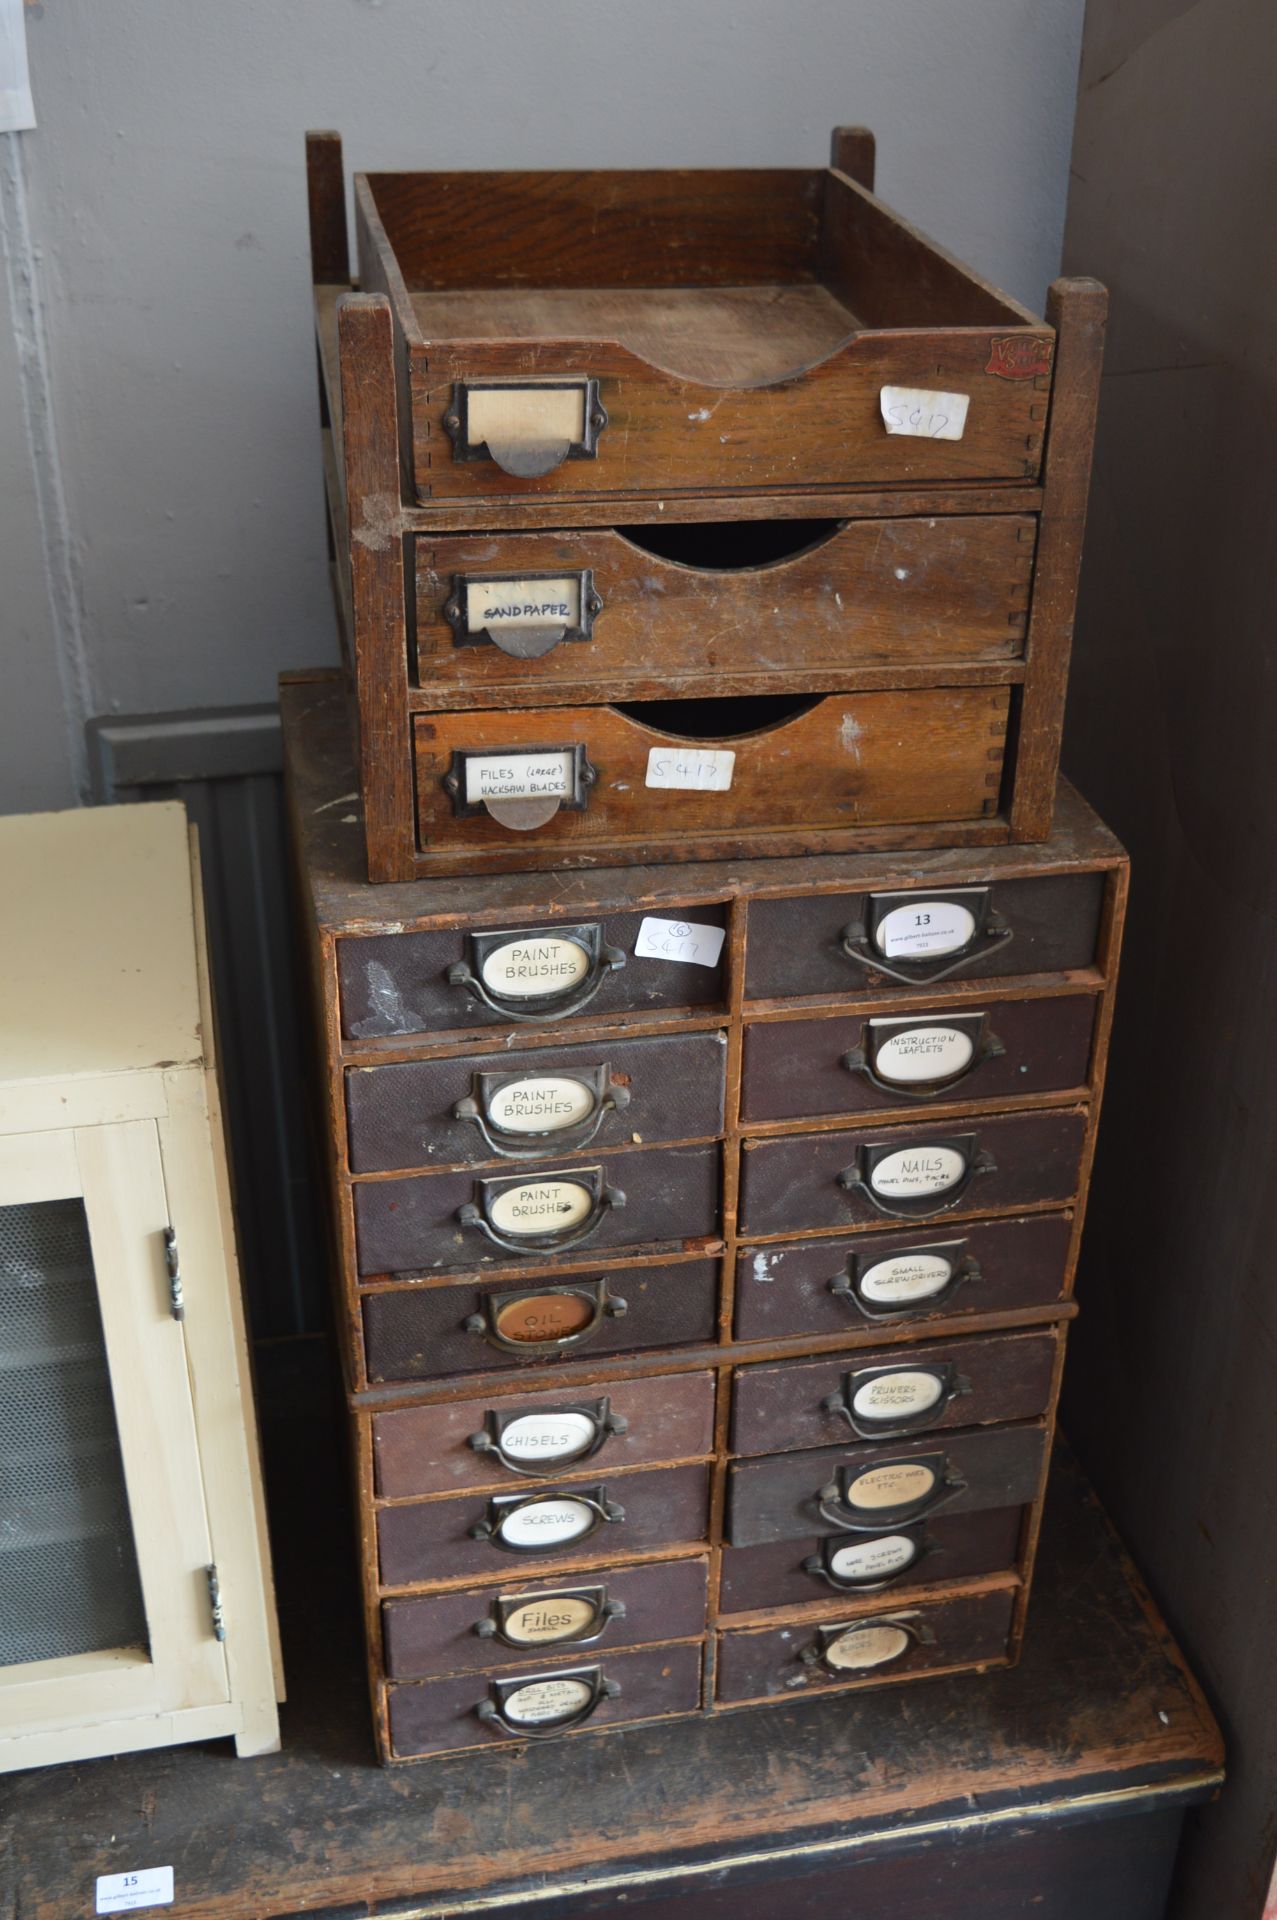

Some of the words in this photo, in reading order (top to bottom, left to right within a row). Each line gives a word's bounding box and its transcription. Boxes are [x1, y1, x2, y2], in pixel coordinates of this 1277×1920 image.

[480, 769, 514, 780] FILES
[481, 785, 525, 795] HACKSAW
[529, 781, 567, 793] BLADES
[914, 914, 931, 927] 13
[511, 946, 561, 961] PAINT
[505, 962, 577, 979] BRUSHES
[890, 1033, 956, 1046] INSTRUCTION
[898, 1044, 944, 1055] LEAFLETS
[512, 1089, 558, 1102] PAINT
[504, 1102, 573, 1116] BRUSHES
[901, 1157, 943, 1173] NAILS
[520, 1188, 560, 1201] PAINT
[892, 1265, 925, 1276] SMALL
[524, 1314, 561, 1325] OIL
[871, 1385, 917, 1395] PRUNERS
[868, 1395, 915, 1404] SCISSORS
[505, 1434, 569, 1447] CHISELS
[522, 1513, 575, 1526] SCREWS
[521, 1611, 572, 1628] Files
[123, 1876, 138, 1887] 15
